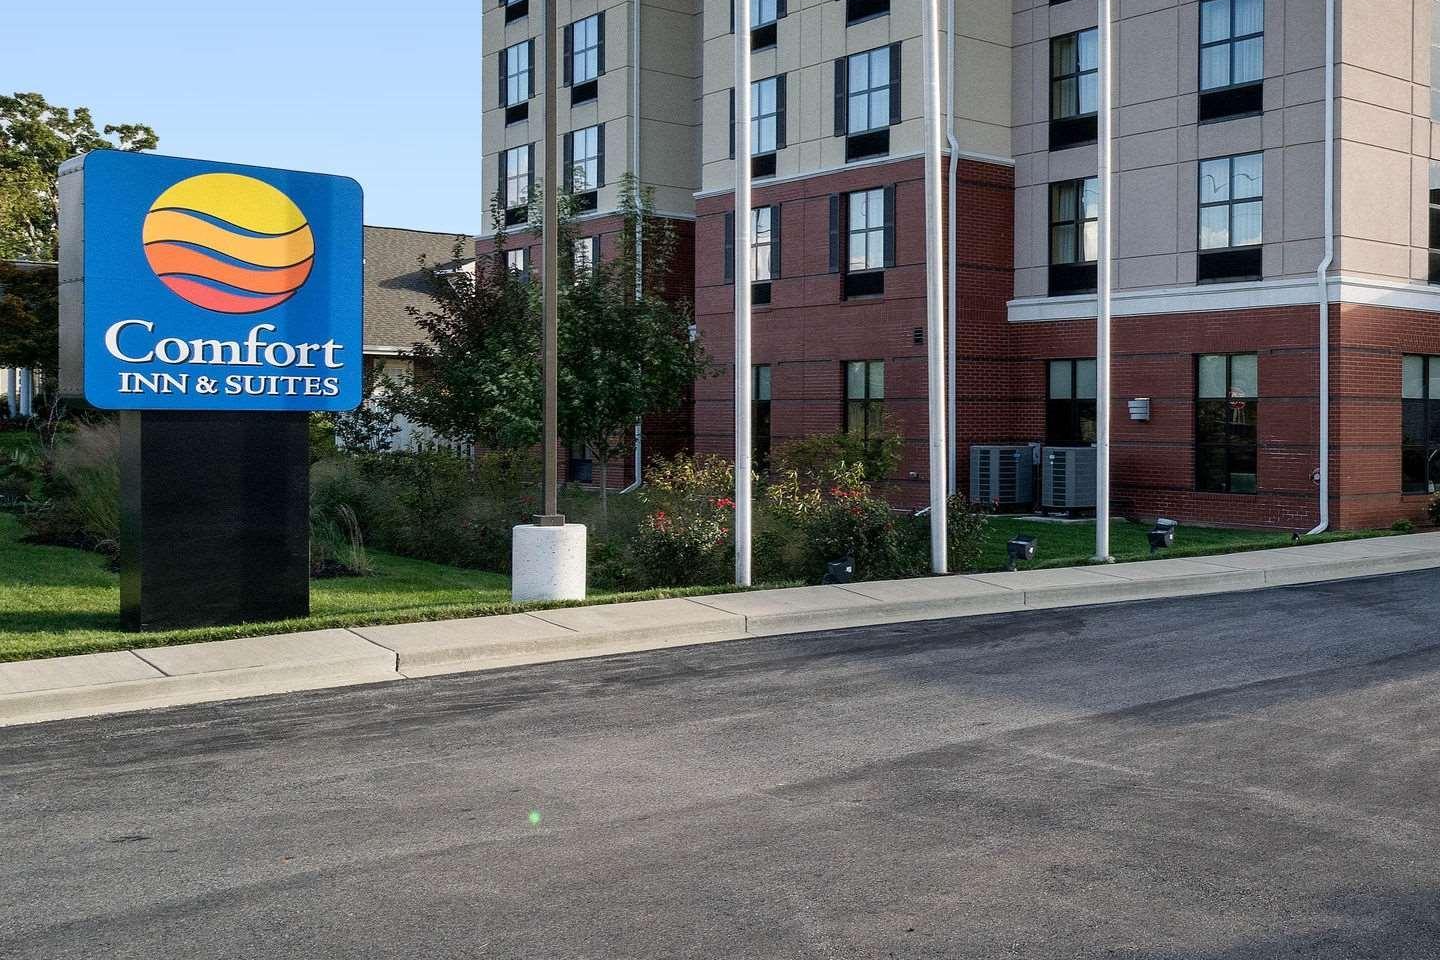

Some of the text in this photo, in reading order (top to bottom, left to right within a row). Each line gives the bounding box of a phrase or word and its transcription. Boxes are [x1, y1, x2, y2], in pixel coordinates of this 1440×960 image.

[105, 320, 344, 368] Comfort
[119, 372, 339, 396] INN & SUITES
